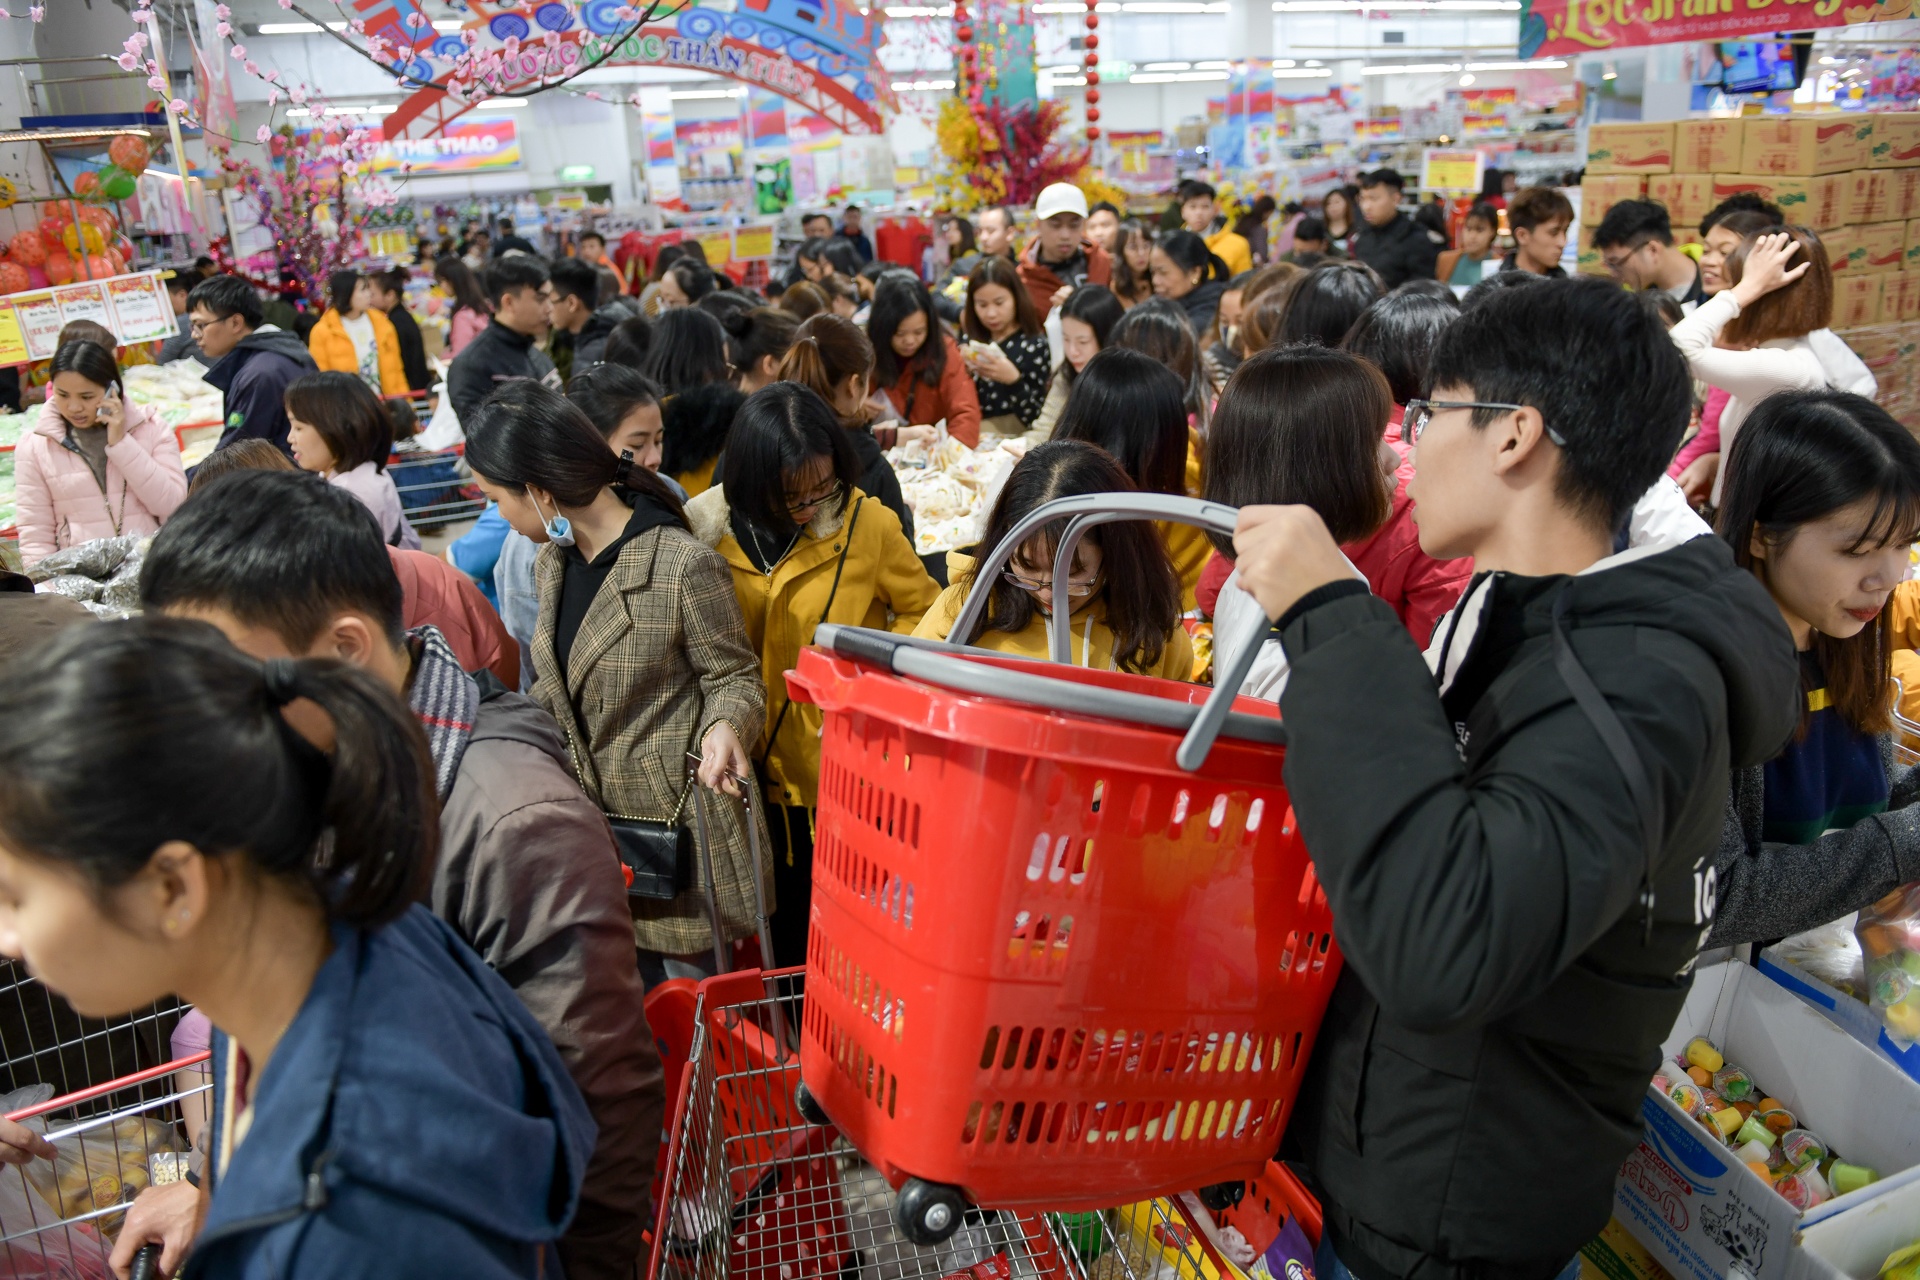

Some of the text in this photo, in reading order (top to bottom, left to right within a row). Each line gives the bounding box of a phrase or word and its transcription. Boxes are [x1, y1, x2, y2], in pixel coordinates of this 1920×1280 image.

[1620, 1183, 1649, 1211] COMPANY
[1646, 1206, 1680, 1243] PROCESSING
[1679, 1240, 1713, 1274] FOODSTUFF
